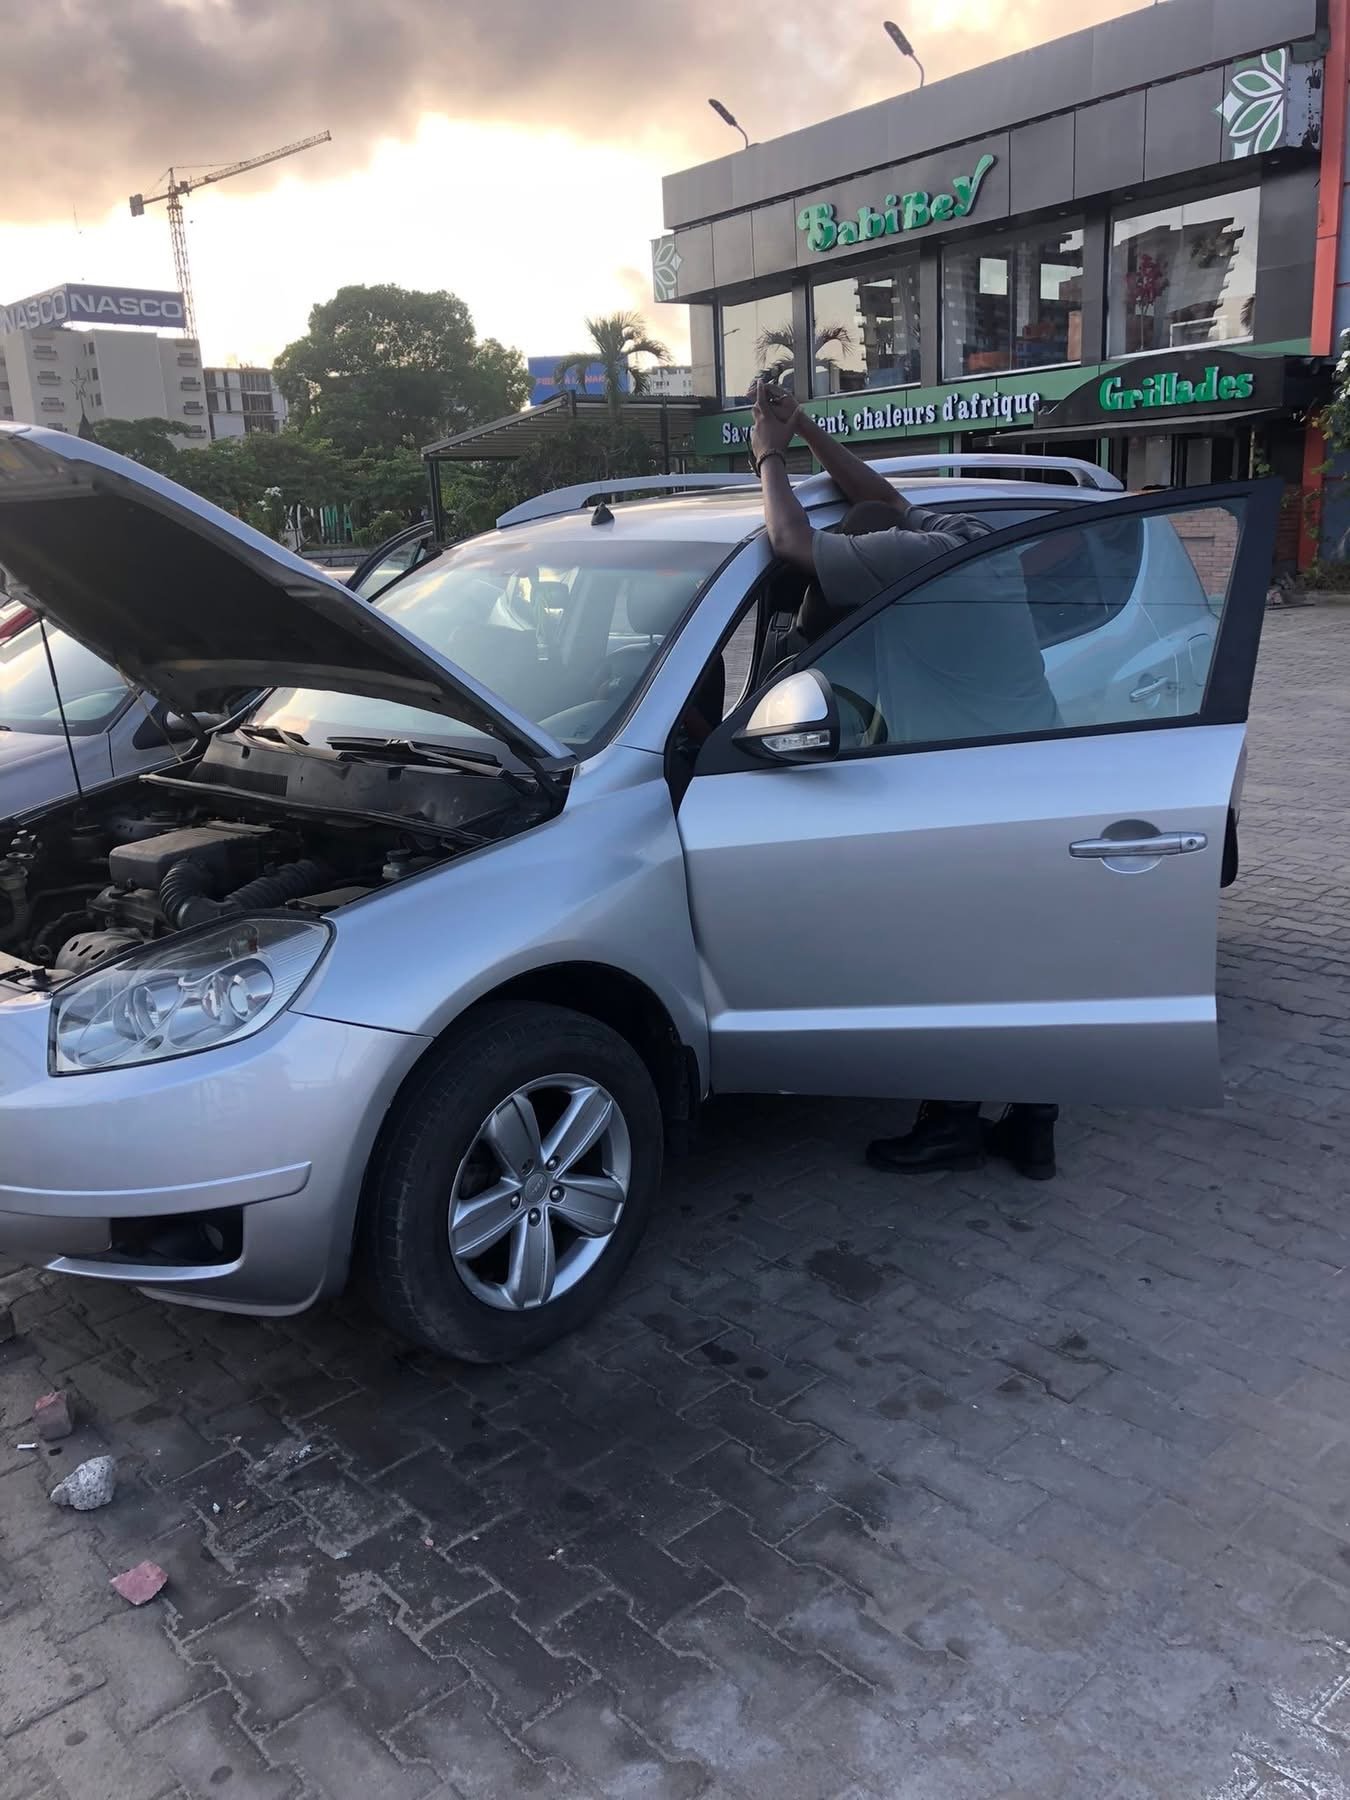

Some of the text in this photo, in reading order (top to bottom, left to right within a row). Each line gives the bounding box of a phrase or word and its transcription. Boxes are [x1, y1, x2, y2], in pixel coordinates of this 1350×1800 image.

[69, 294, 182, 319] NASCO
[1099, 365, 1254, 411] Grillades
[852, 403, 937, 431] chaleurs
[942, 391, 1041, 423] d'afrique
